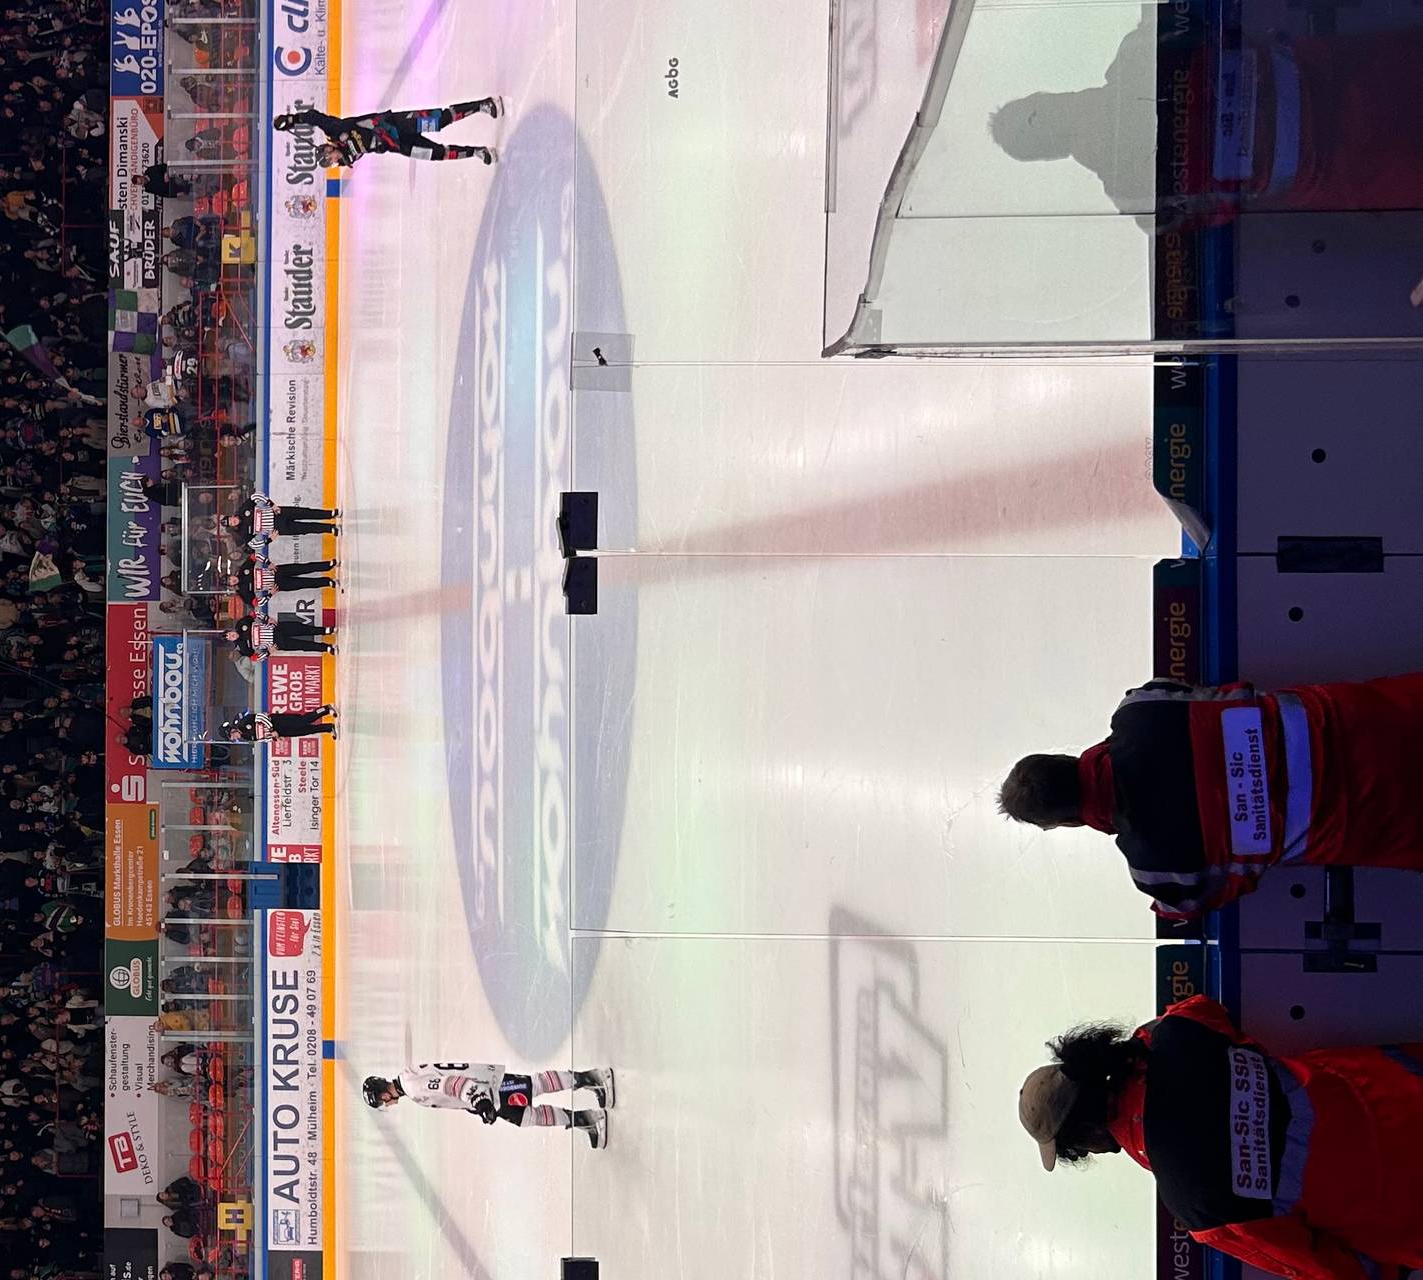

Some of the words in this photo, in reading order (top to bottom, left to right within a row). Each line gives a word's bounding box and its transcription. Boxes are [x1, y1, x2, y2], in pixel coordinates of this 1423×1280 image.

[664, 58, 679, 99] AGbG
[116, 117, 127, 177] Dimanski
[109, 220, 120, 278] SAUF
[142, 219, 155, 279] BRÜDER
[284, 244, 316, 330] Stauder
[110, 353, 131, 449] Bierstandstürmer
[286, 380, 296, 423] Revision
[285, 427, 296, 480] Märkische
[1164, 422, 1192, 498] nergie
[117, 555, 151, 598] WIR
[129, 608, 146, 662] Essen
[271, 664, 287, 714] REWE
[289, 671, 302, 711] GROB
[304, 664, 320, 694] MARKT
[298, 761, 307, 793] Steele
[310, 761, 319, 772] 14
[310, 776, 319, 792] Tor
[1230, 751, 1245, 778] Sic
[1245, 727, 1267, 841] Sanitätsdienst
[271, 760, 280, 835] Altenessen-Süd
[310, 796, 321, 830] Isinger
[1234, 793, 1249, 822] San
[113, 819, 121, 844] Essen
[113, 846, 121, 890] Markthalle
[113, 892, 121, 926] GLOBUS
[132, 960, 140, 996] GLOBUS
[307, 970, 317, 984] 69
[307, 987, 317, 1001] 07
[272, 970, 300, 1092] KRUSE
[307, 1005, 317, 1018] 49
[108, 1028, 117, 1091] Schaufenster-
[147, 1024, 155, 1091] Merchandising
[307, 1030, 317, 1056] 0208
[121, 1043, 131, 1091] gestaltung
[134, 1063, 143, 1091] Visual
[307, 1060, 317, 1079] Tel.
[1232, 1051, 1250, 1093] SSD
[126, 1111, 142, 1141] STYLE
[307, 1091, 318, 1141] Mülheim
[1248, 1056, 1268, 1191] Sanitätsdienst
[272, 1104, 300, 1204] AUTO
[308, 1152, 318, 1165] 48
[1233, 1101, 1252, 1189] San-Sic
[140, 1154, 154, 1185] DEKO
[225, 1209, 244, 1224] H
[307, 1169, 318, 1244] Humboldtstr.
